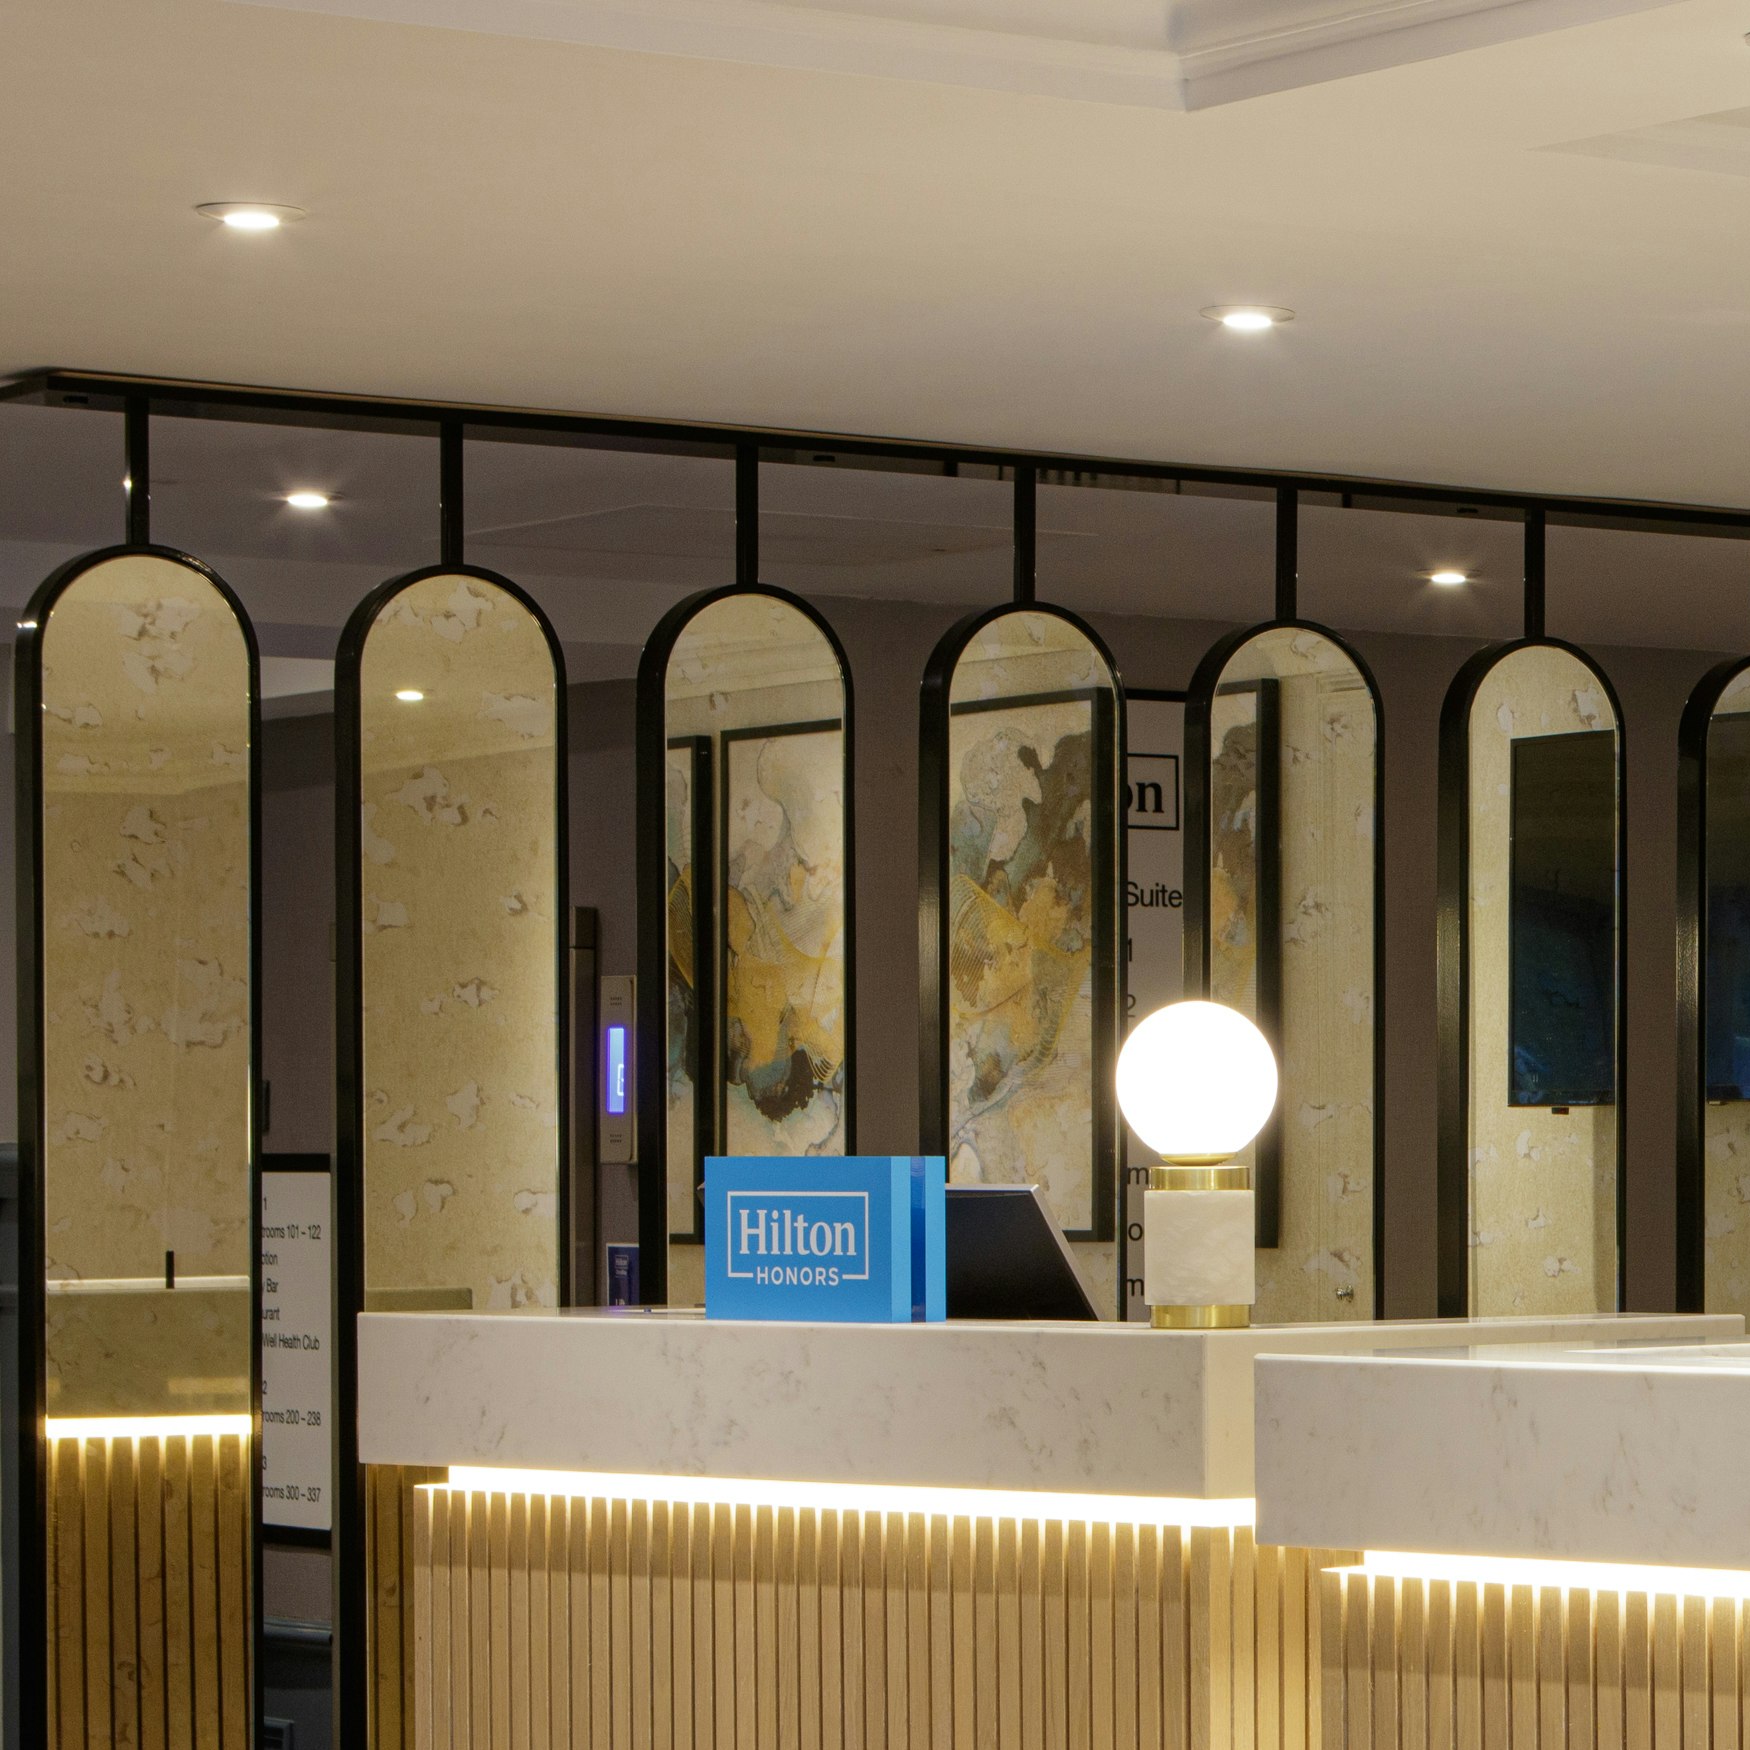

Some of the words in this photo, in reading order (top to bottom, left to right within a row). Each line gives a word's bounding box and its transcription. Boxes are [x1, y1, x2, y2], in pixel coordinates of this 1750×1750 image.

[1127, 881, 1183, 908] Suite
[308, 1224, 321, 1240] 122
[739, 1210, 857, 1256] Hilton
[757, 1266, 839, 1286] HONORS
[279, 1333, 301, 1350] Health
[303, 1334, 320, 1351] Club
[286, 1409, 299, 1425] 200
